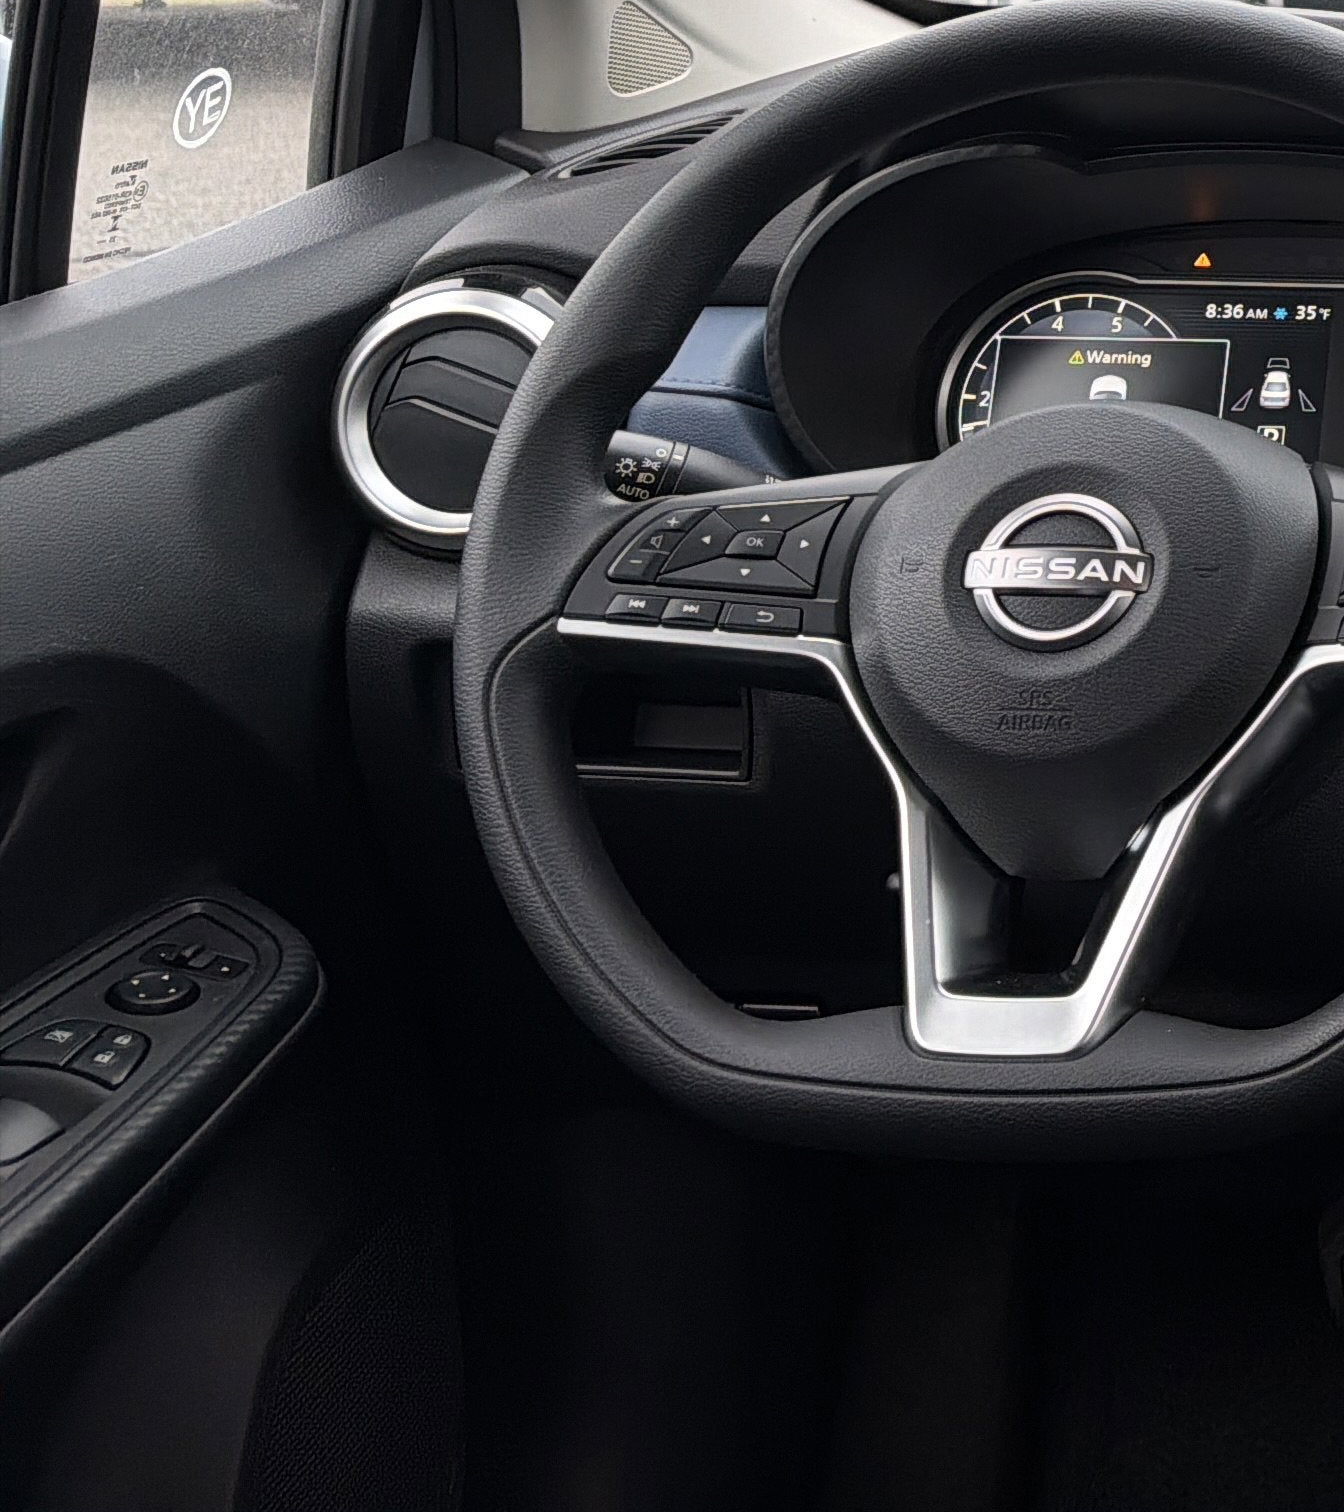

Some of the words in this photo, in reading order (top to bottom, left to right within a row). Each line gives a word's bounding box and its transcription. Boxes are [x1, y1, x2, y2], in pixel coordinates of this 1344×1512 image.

[1205, 304, 1244, 319] 8:36
[1246, 309, 1268, 319] AM
[1052, 317, 1064, 332] 4
[1112, 318, 1122, 333] 5
[1086, 350, 1152, 368] Warning
[978, 391, 990, 407] 2
[616, 483, 650, 500] AUTO
[746, 537, 764, 548] OK
[969, 556, 1146, 584] NISSAN
[998, 713, 1073, 731] AIRBAG
